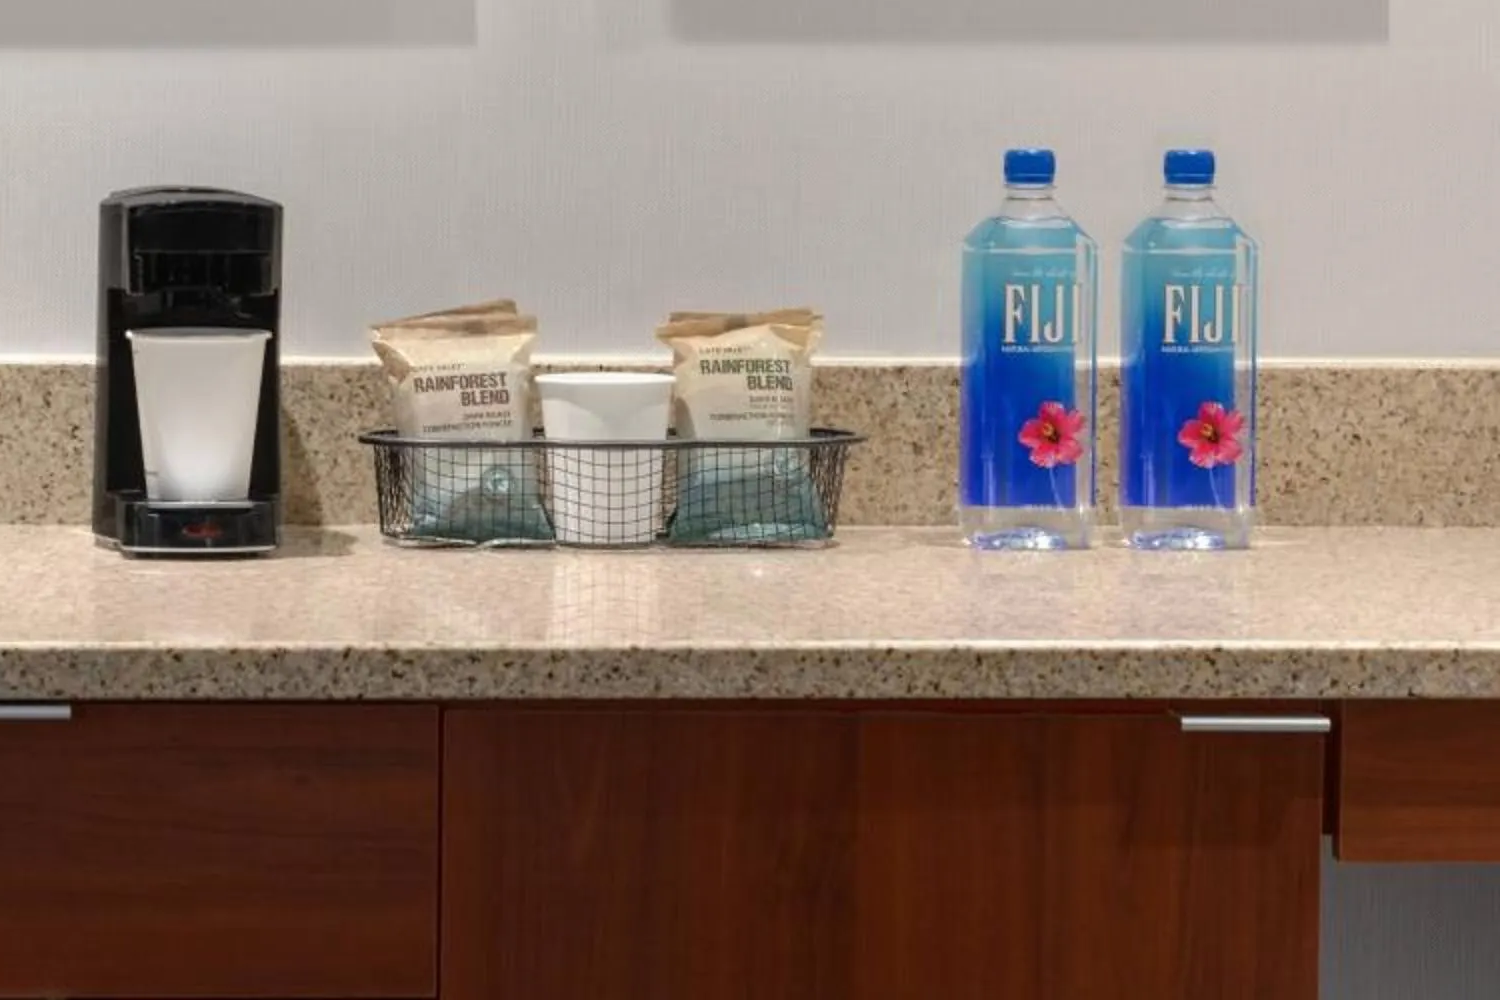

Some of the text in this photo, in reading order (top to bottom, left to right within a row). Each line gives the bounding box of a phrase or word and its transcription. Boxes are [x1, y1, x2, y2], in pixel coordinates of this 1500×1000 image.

[1003, 284, 1081, 343] FIJI
[1163, 284, 1242, 343] FIJI
[700, 359, 789, 375] RAINFOREST
[413, 372, 506, 393] RAINFOREST
[746, 375, 793, 391] BLEND
[461, 389, 509, 407] BLEND
